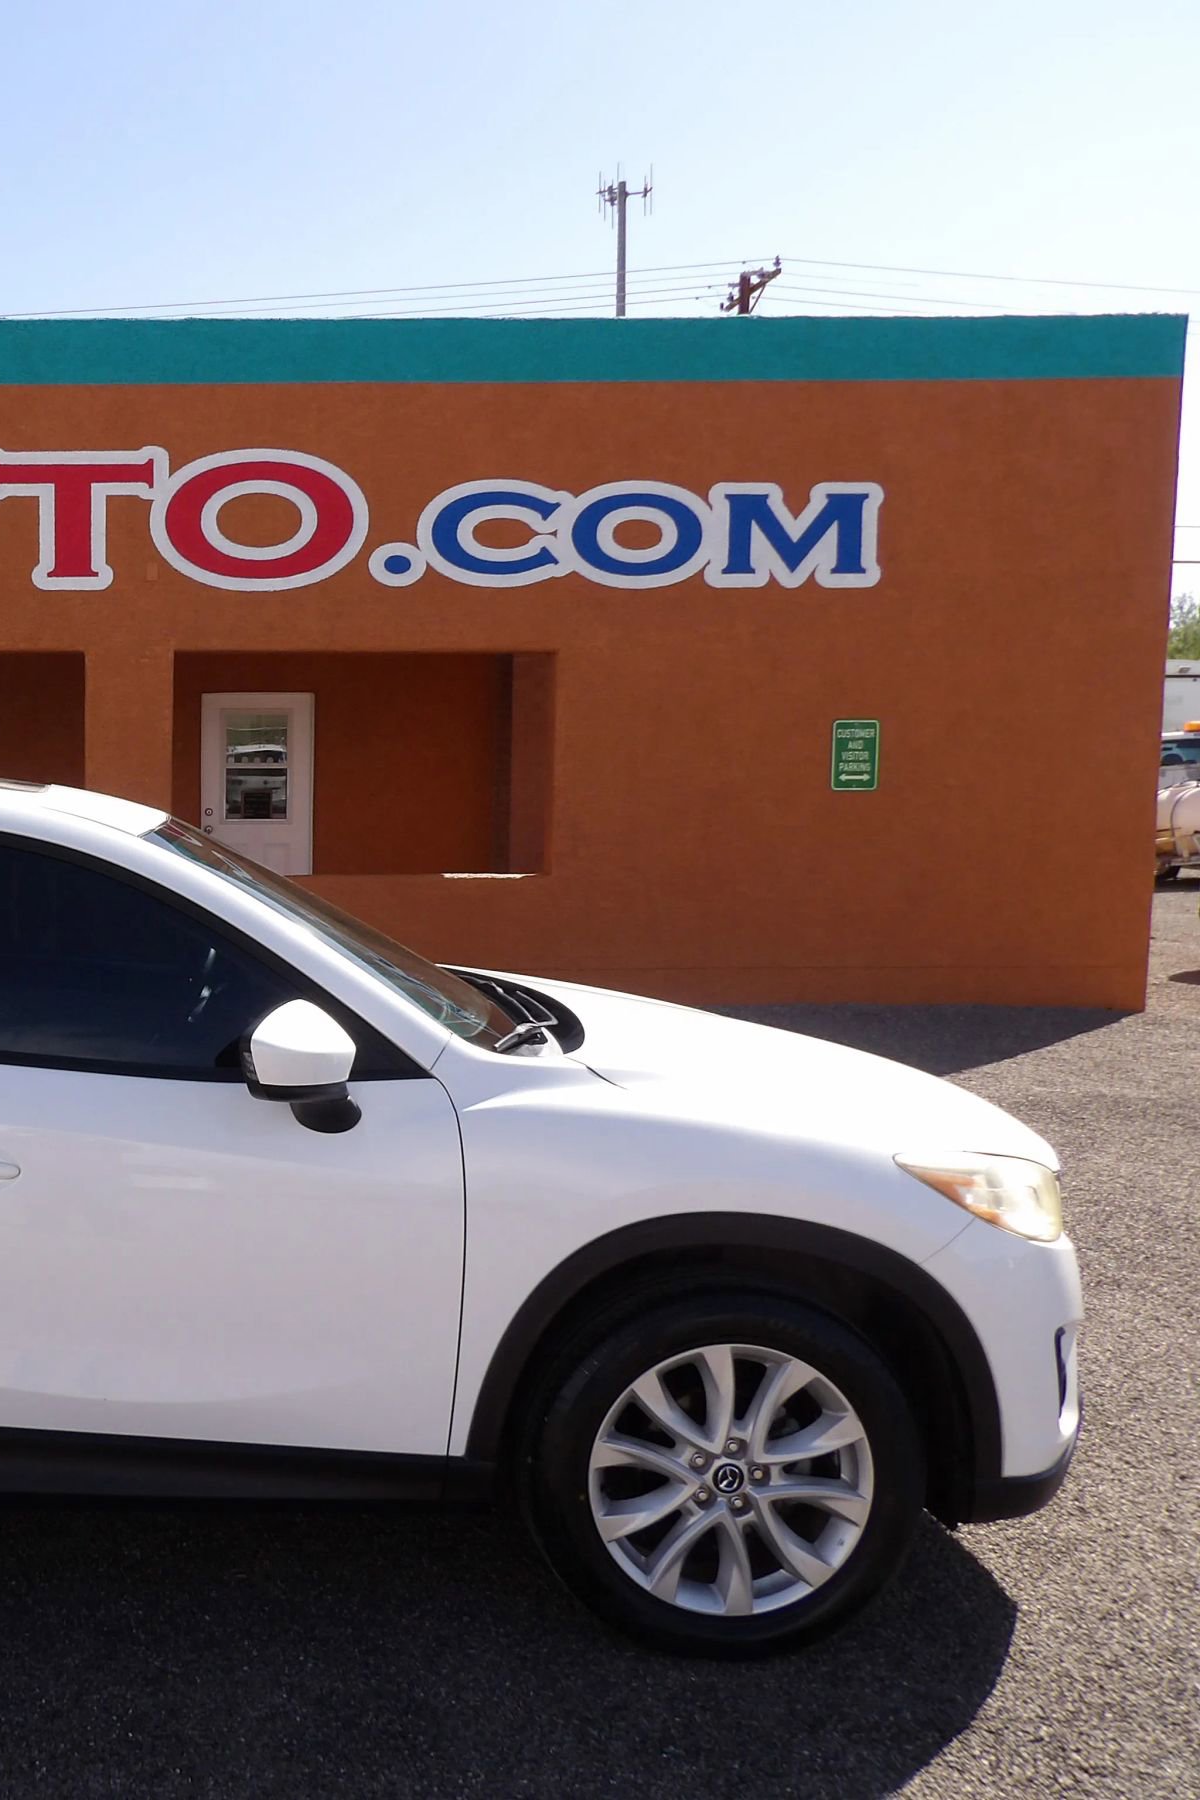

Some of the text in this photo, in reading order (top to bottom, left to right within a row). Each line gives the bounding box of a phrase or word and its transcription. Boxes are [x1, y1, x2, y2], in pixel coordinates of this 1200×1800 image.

[837, 728, 875, 738] CUSTOMER
[848, 740, 864, 750] AND
[841, 752, 869, 760] VISITOR
[838, 762, 871, 772] PARKING
